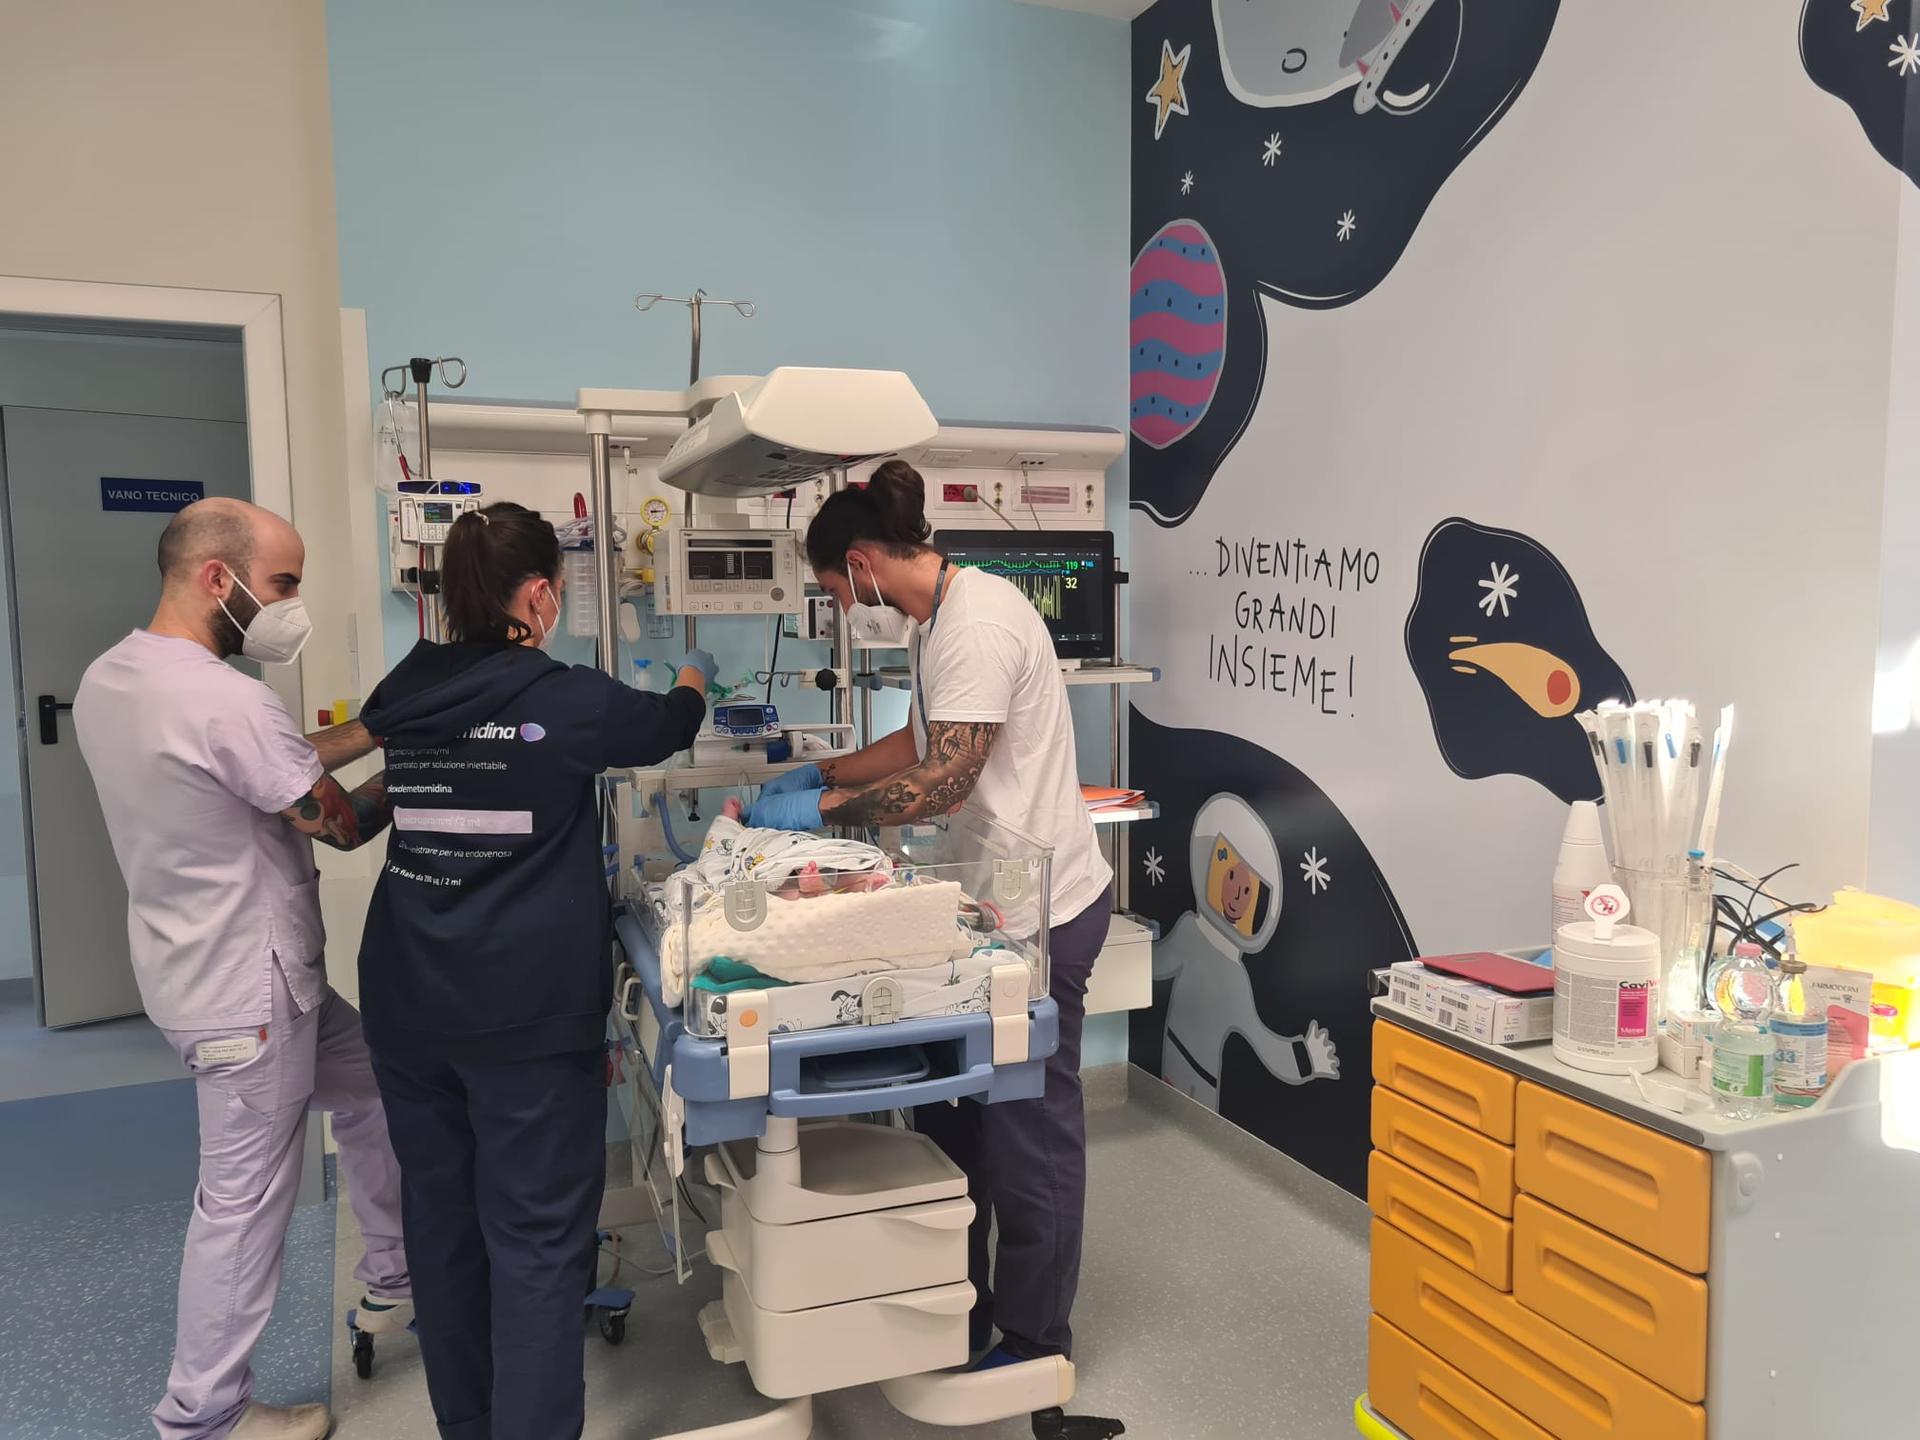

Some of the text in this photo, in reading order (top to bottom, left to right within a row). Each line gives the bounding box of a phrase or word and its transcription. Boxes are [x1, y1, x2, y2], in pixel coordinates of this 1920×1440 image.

[107, 490, 199, 502] VANO TECNICO
[1066, 561, 1078, 570] 119
[1065, 577, 1078, 589] 32
[1234, 591, 1336, 640] GRANDI
[419, 762, 431, 770] per
[432, 761, 465, 769] soluzione
[467, 761, 508, 770] iniettabile
[438, 849, 453, 857] per
[454, 850, 465, 858] via
[389, 865, 400, 873] 25
[400, 868, 415, 879] fiale
[415, 873, 424, 881] da
[450, 878, 462, 886] ml
